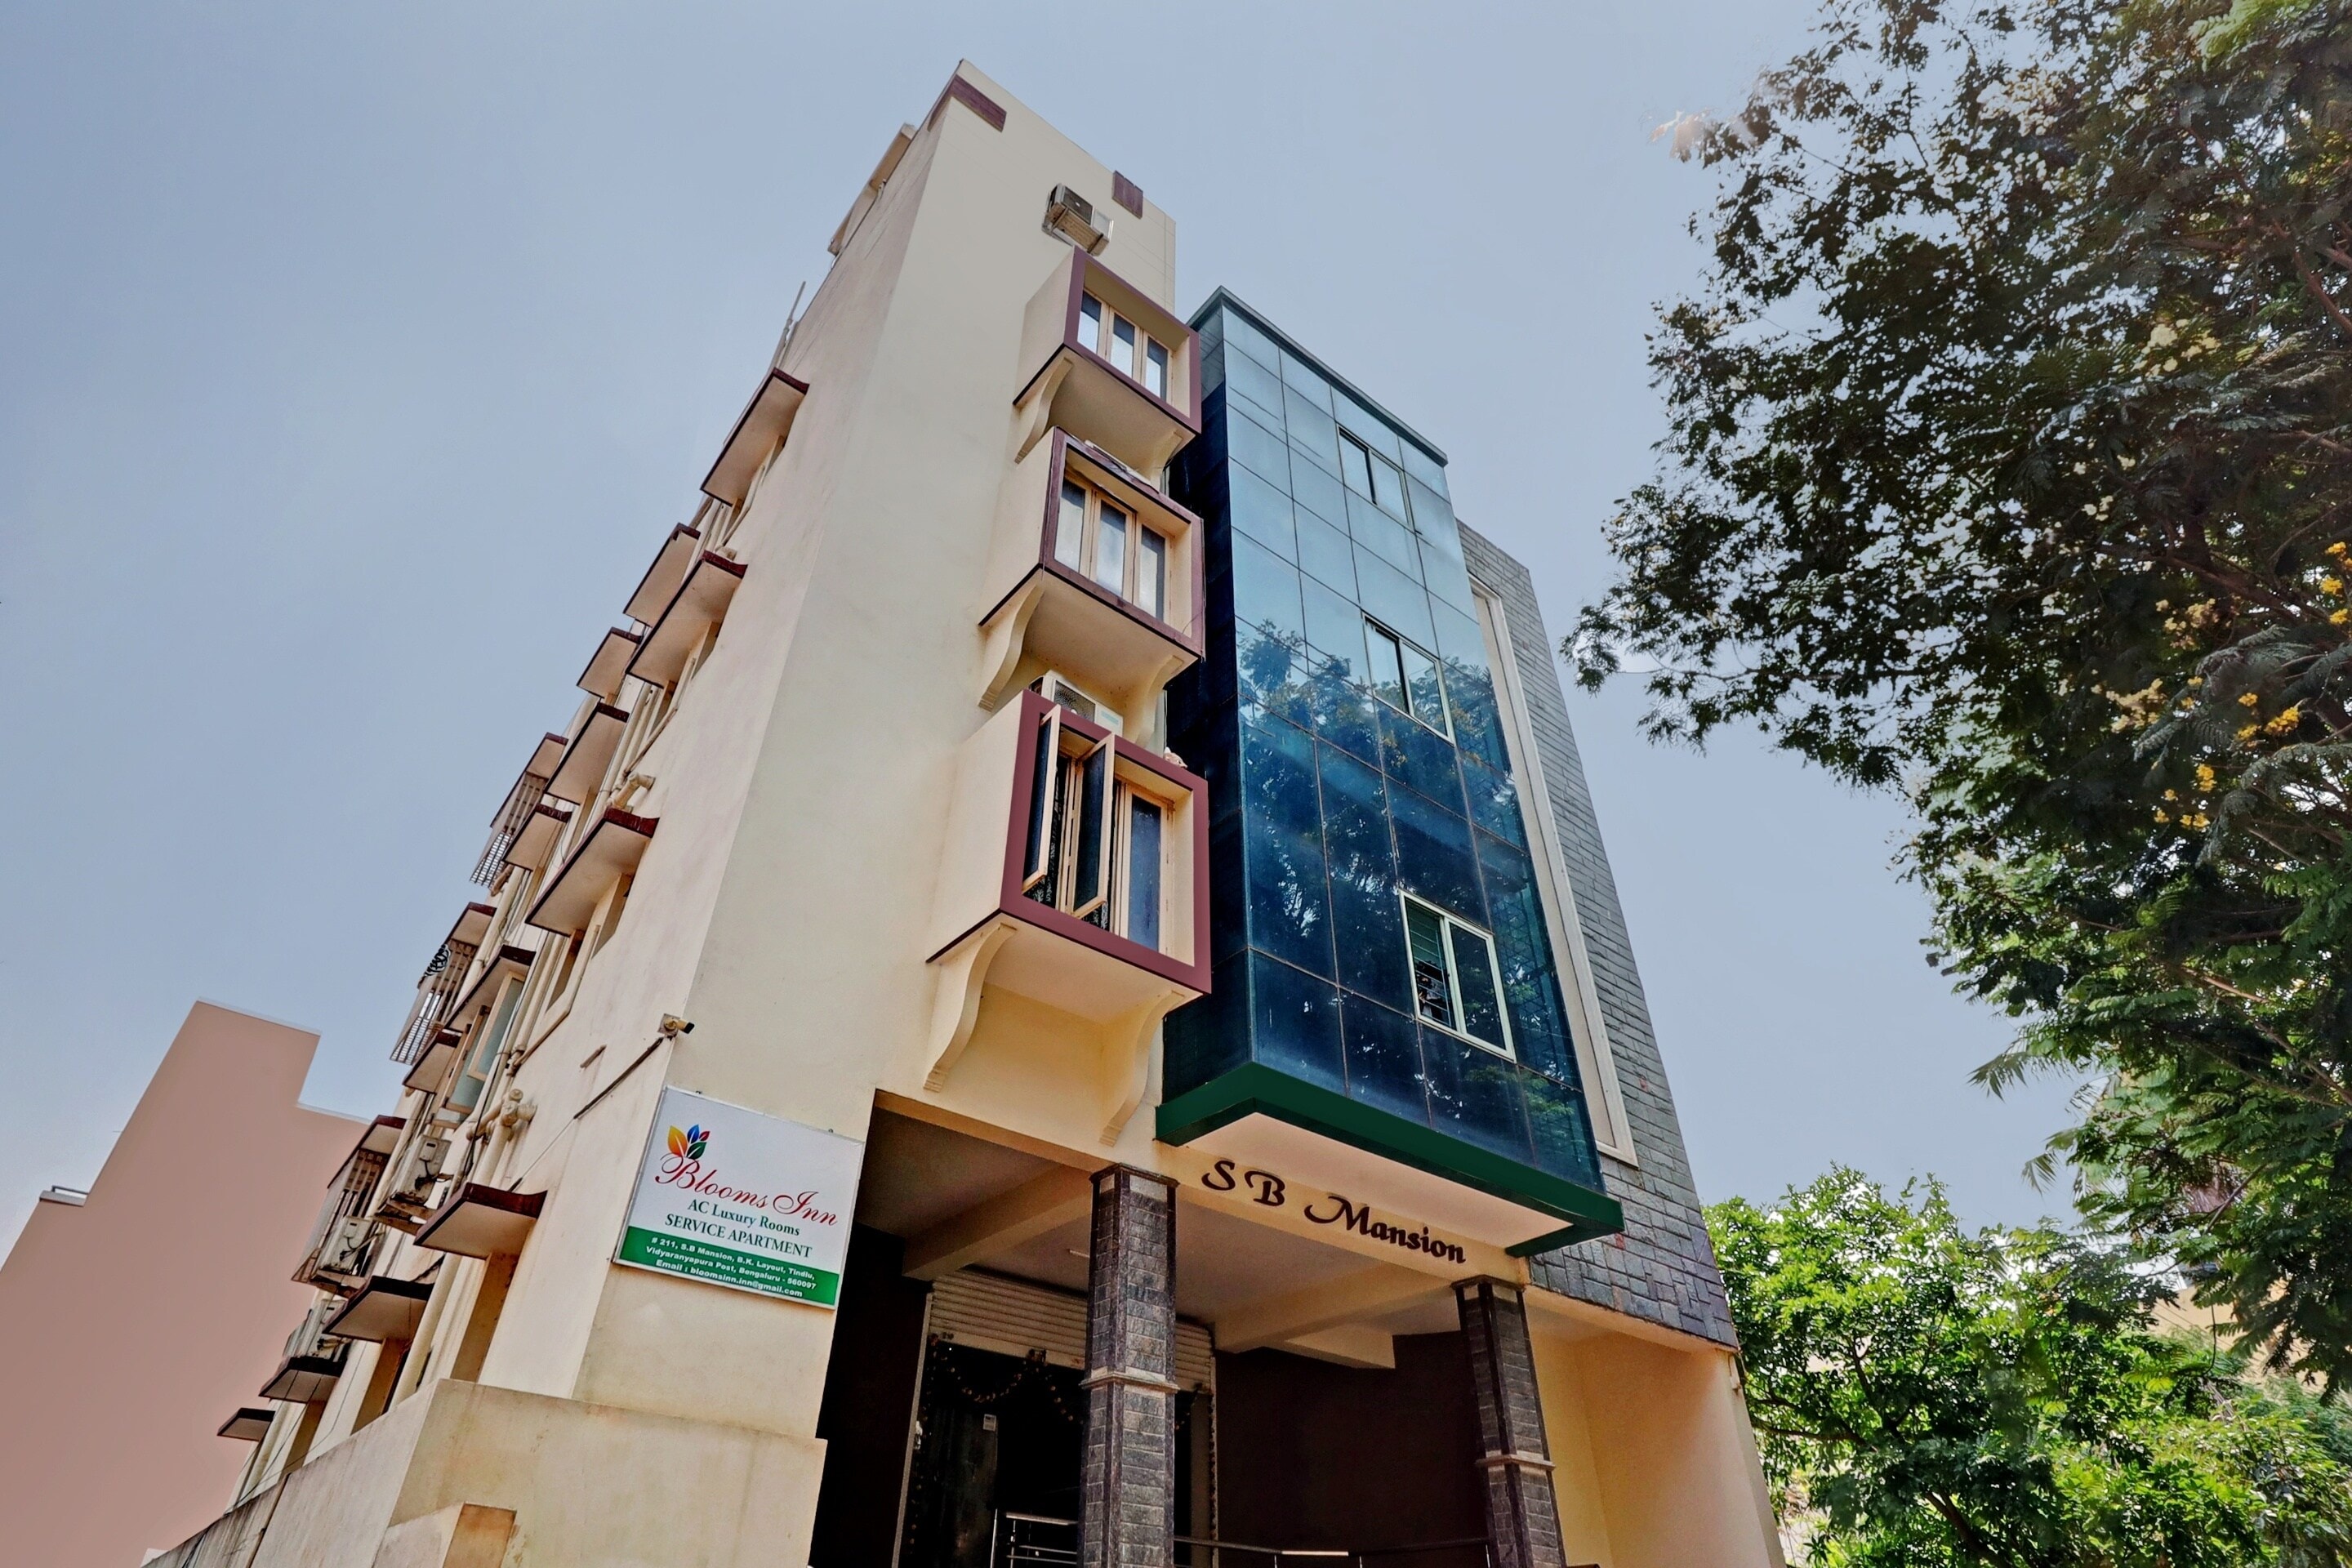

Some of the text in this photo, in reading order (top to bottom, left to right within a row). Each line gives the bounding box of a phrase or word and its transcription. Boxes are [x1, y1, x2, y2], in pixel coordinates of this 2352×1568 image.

[655, 1153, 838, 1226] Blooms Inn
[665, 1214, 813, 1258] SERVICE APARTMENT
[688, 1199, 800, 1236] AC Luxury Rooms
[1304, 1196, 1466, 1263] Mansion
[646, 1246, 714, 1267] Vidyaranyapura
[715, 1262, 737, 1273] Post,
[738, 1267, 781, 1282] Bengaluru
[786, 1277, 817, 1290] 560097
[656, 1259, 684, 1272] Email
[659, 1239, 679, 1250] 211,
[680, 1243, 696, 1253] S.B
[697, 1247, 735, 1263] Mansion,
[756, 1260, 786, 1274] Layout,
[788, 1267, 815, 1281] Tindlu,
